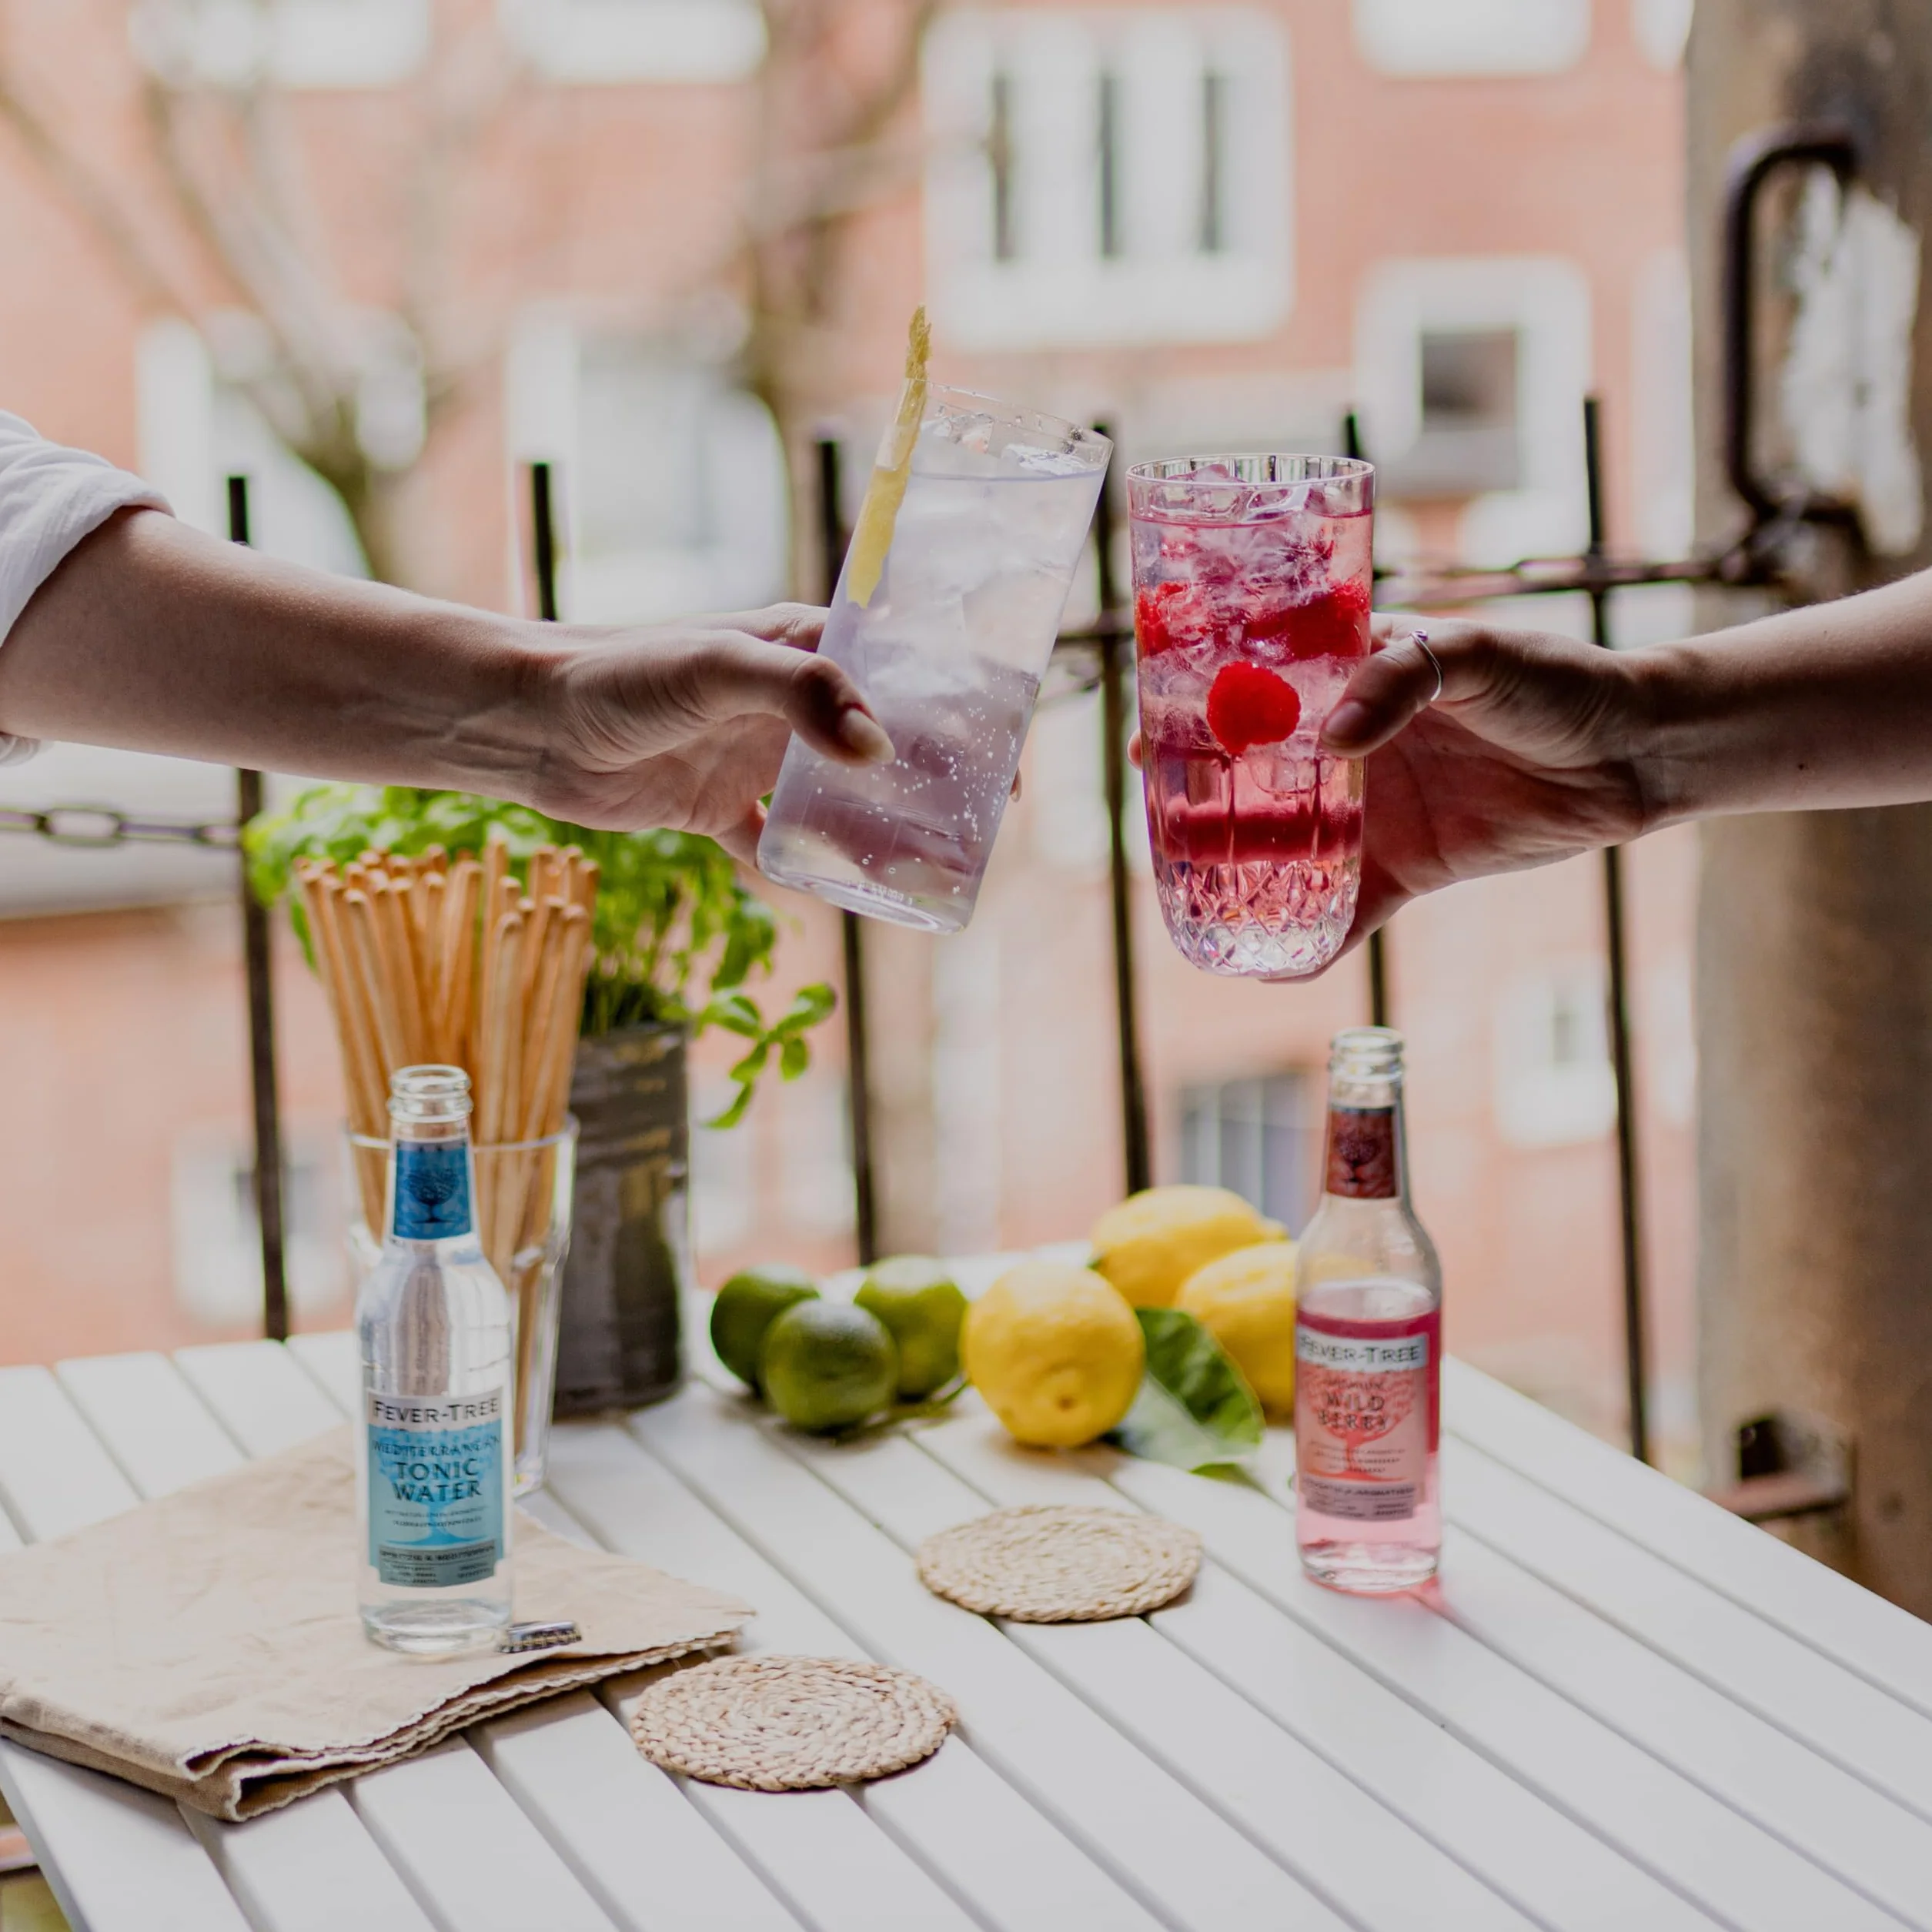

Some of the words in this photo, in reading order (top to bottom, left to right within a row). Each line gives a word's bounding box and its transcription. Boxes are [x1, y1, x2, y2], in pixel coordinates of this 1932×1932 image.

[1298, 1335, 1422, 1364] FEVER-TREE
[373, 1398, 500, 1423] FEVER-TREE
[1325, 1389, 1385, 1412] WILD
[371, 1434, 500, 1457] MEDITERRANEAN
[393, 1458, 479, 1481] TONIC
[392, 1480, 483, 1502] WATER
